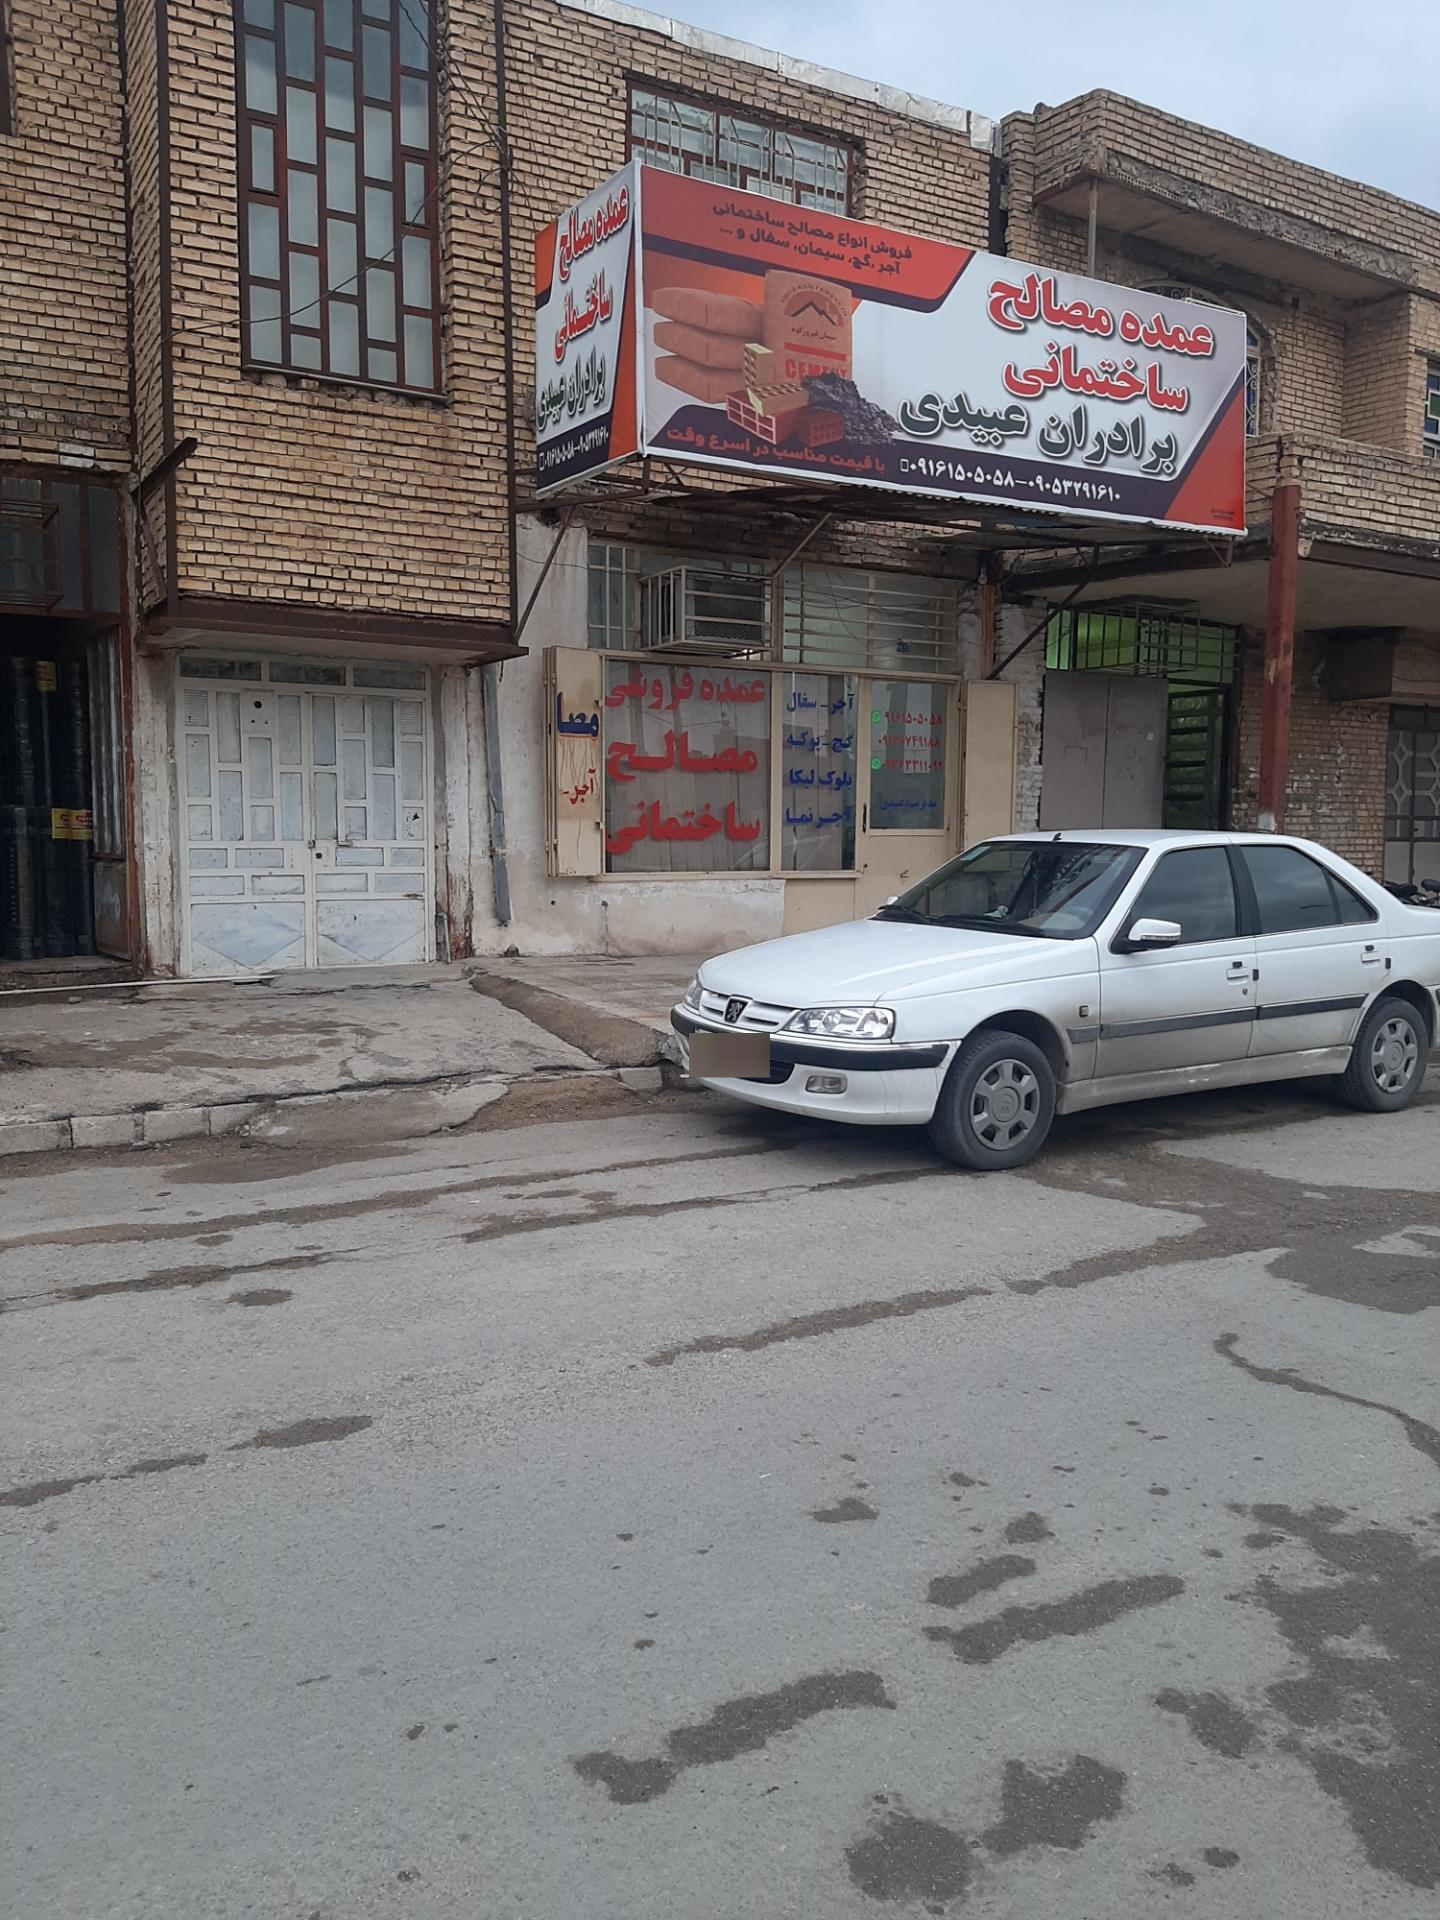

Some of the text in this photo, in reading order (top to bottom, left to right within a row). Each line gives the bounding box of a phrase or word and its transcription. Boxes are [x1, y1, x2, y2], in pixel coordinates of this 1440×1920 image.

[559, 184, 629, 281] عمده مصالح
[713, 203, 912, 259] فروش انواع مصالح ساختمانی
[736, 227, 746, 240] و
[750, 229, 790, 248] سفال
[878, 261, 901, 275] آجر
[554, 270, 613, 362] ساختمانی
[988, 272, 1214, 355] عمده مصالح
[537, 346, 605, 430] برادران عبیدی
[1002, 341, 1187, 411] ساختمانی
[666, 426, 886, 474] با قیمت مناسب در اسرع وقت
[898, 391, 1179, 474] برادران عبیدی
[605, 667, 765, 711] عمده فروشی
[786, 691, 817, 712] سفال
[831, 693, 855, 715] آجر
[607, 729, 758, 782] مصالح
[789, 768, 852, 791] بلوک لیکا
[570, 768, 596, 805] آجر
[605, 800, 760, 855] ساختمانی
[785, 807, 814, 825] نما
